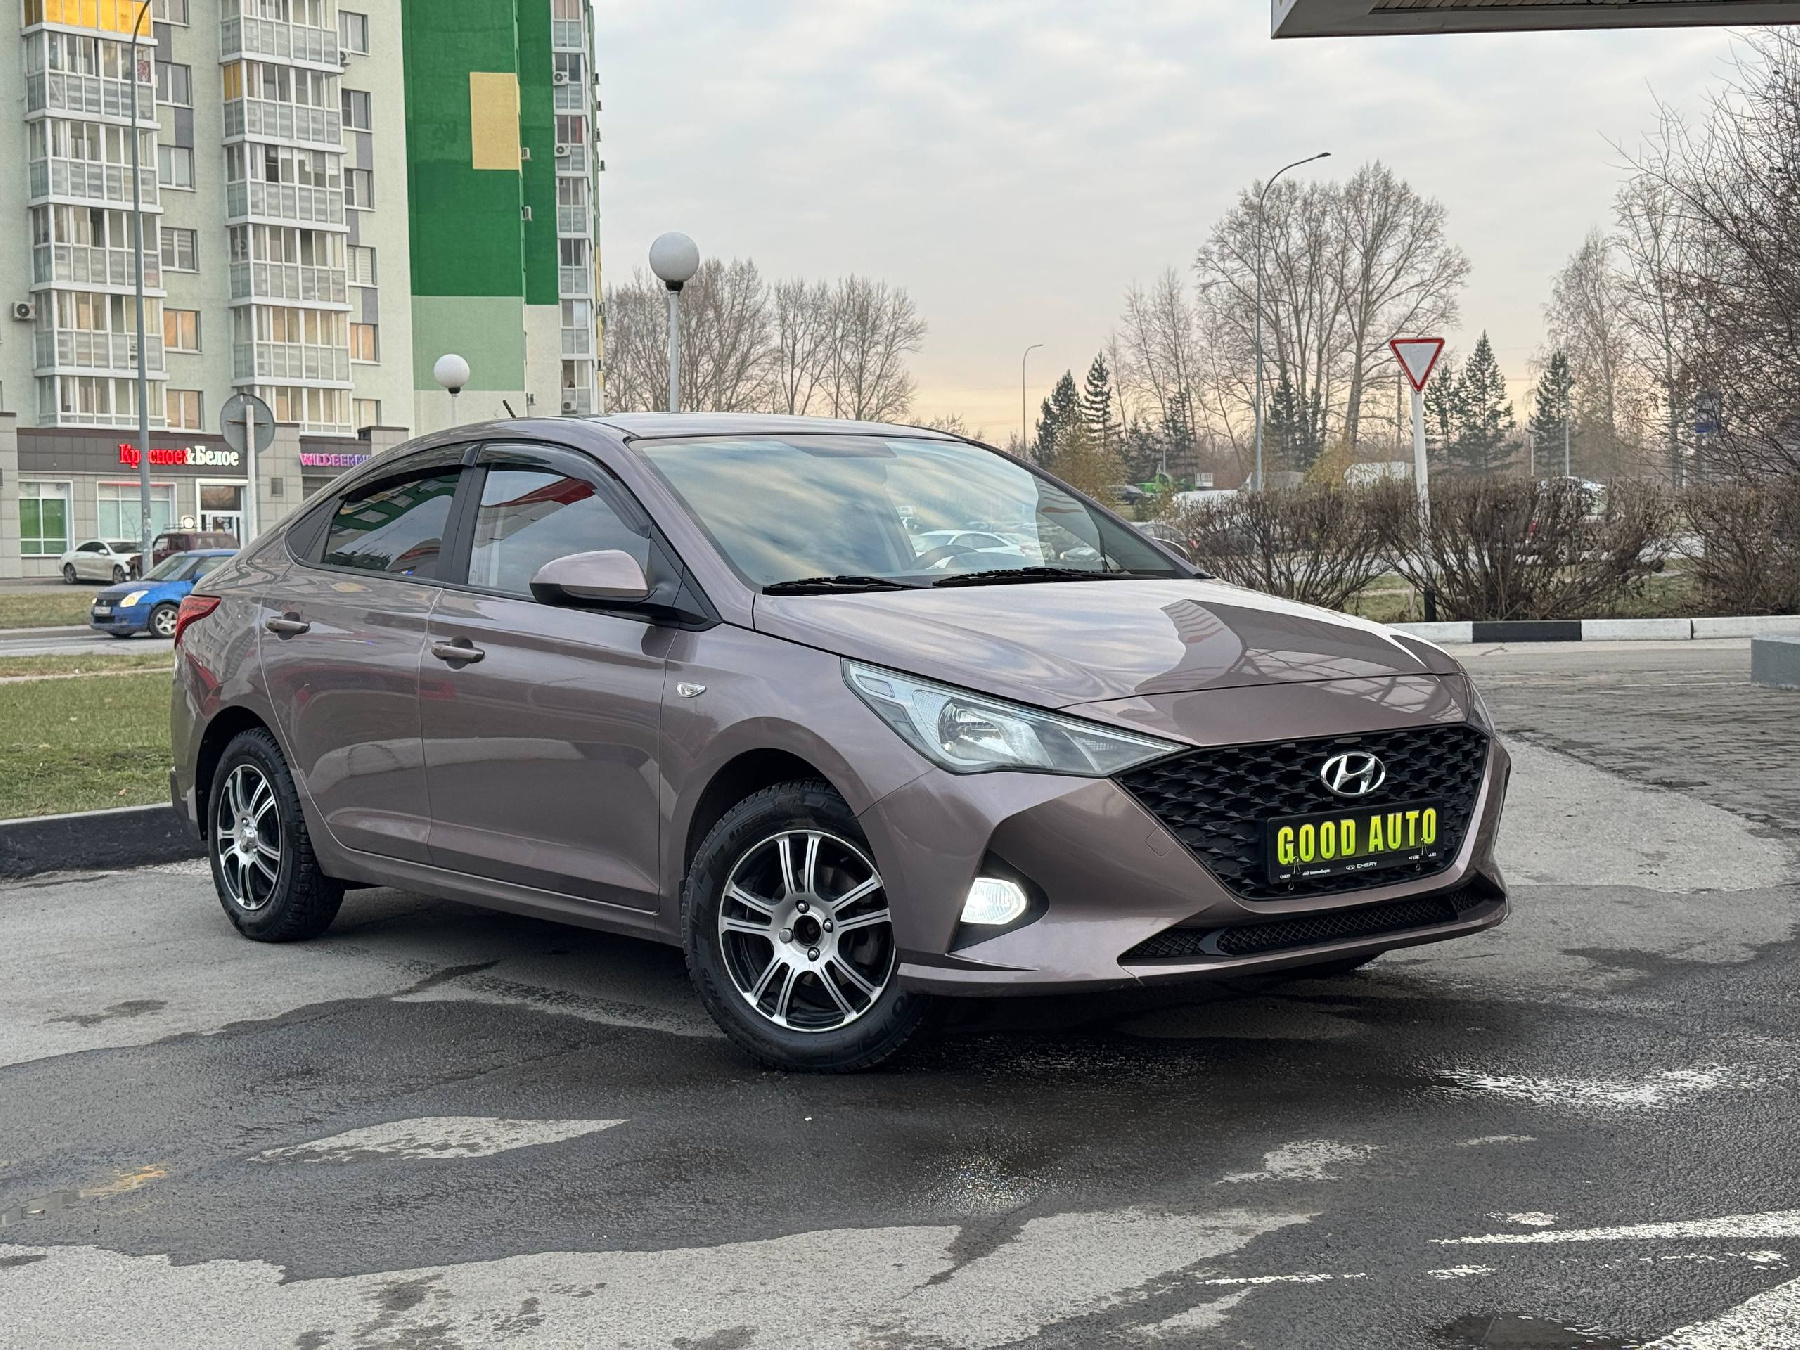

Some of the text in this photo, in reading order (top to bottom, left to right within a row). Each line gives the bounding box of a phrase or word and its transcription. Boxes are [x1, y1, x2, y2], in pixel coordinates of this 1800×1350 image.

[119, 444, 239, 468] Крсное&Белое
[1277, 807, 1437, 866] GOOD AUTO
